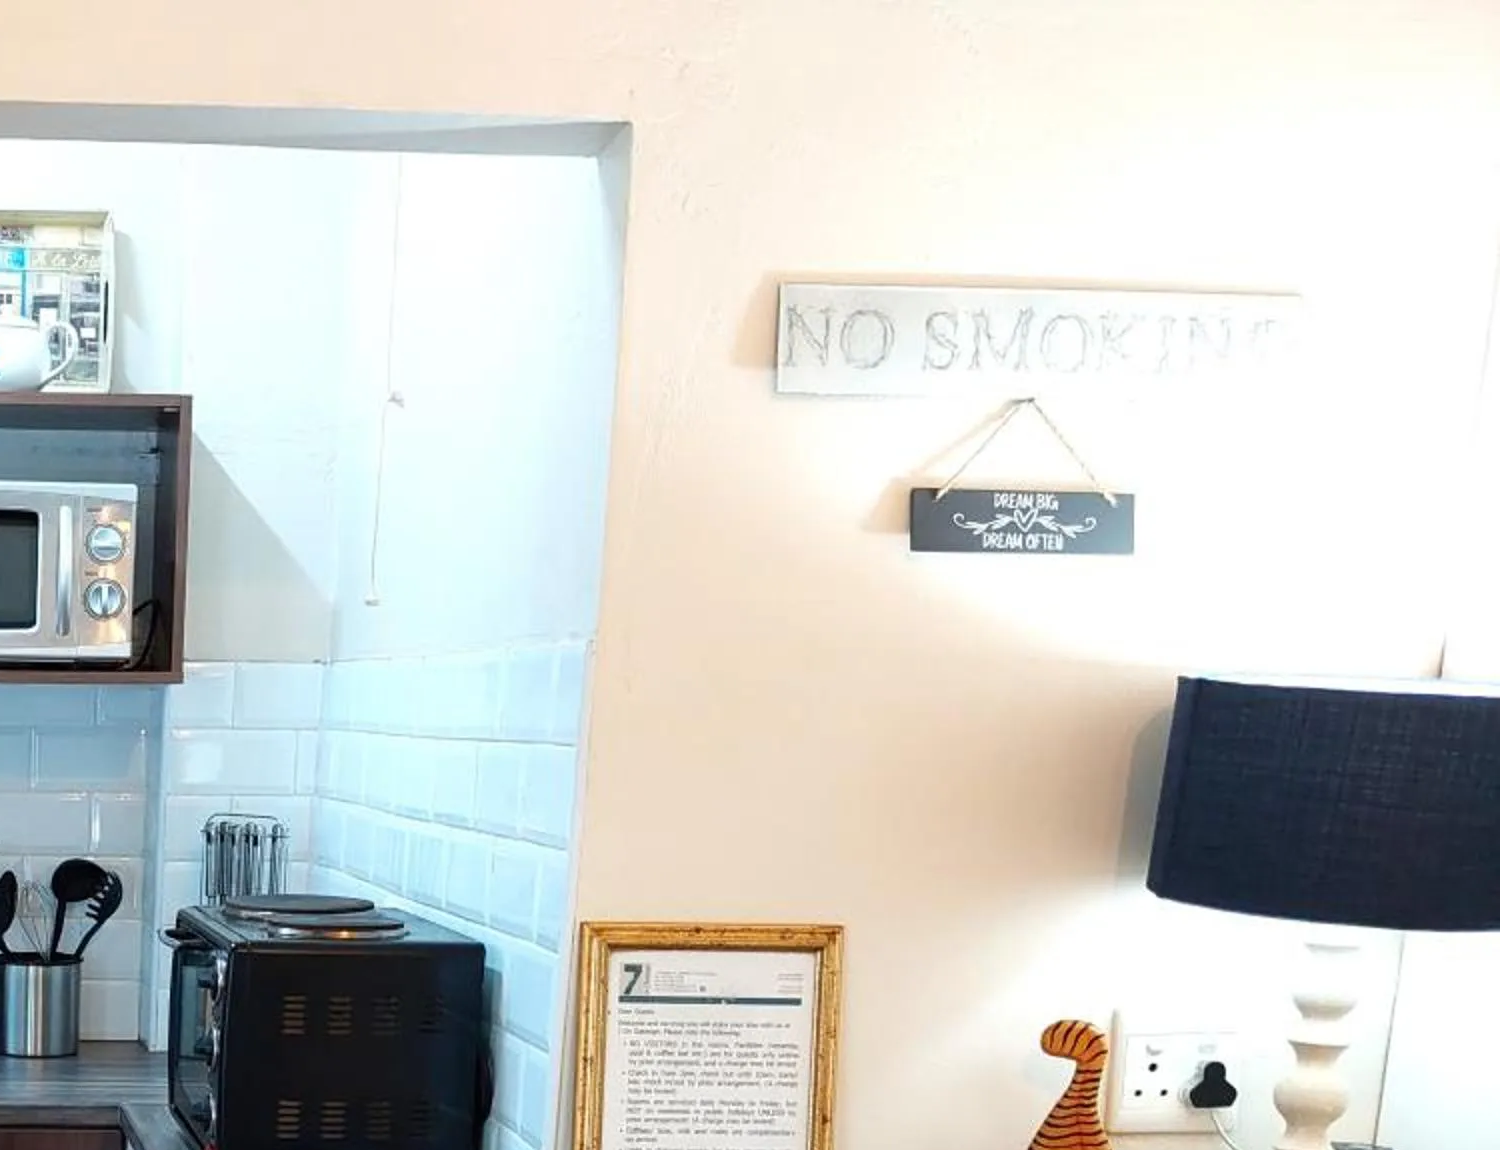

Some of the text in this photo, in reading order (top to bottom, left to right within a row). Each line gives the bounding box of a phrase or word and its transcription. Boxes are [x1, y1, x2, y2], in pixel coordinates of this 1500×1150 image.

[784, 303, 895, 370] NO
[993, 493, 1060, 511] DREAM BIG
[982, 532, 1064, 551] DREAM OFTEN
[623, 963, 643, 995] 7
